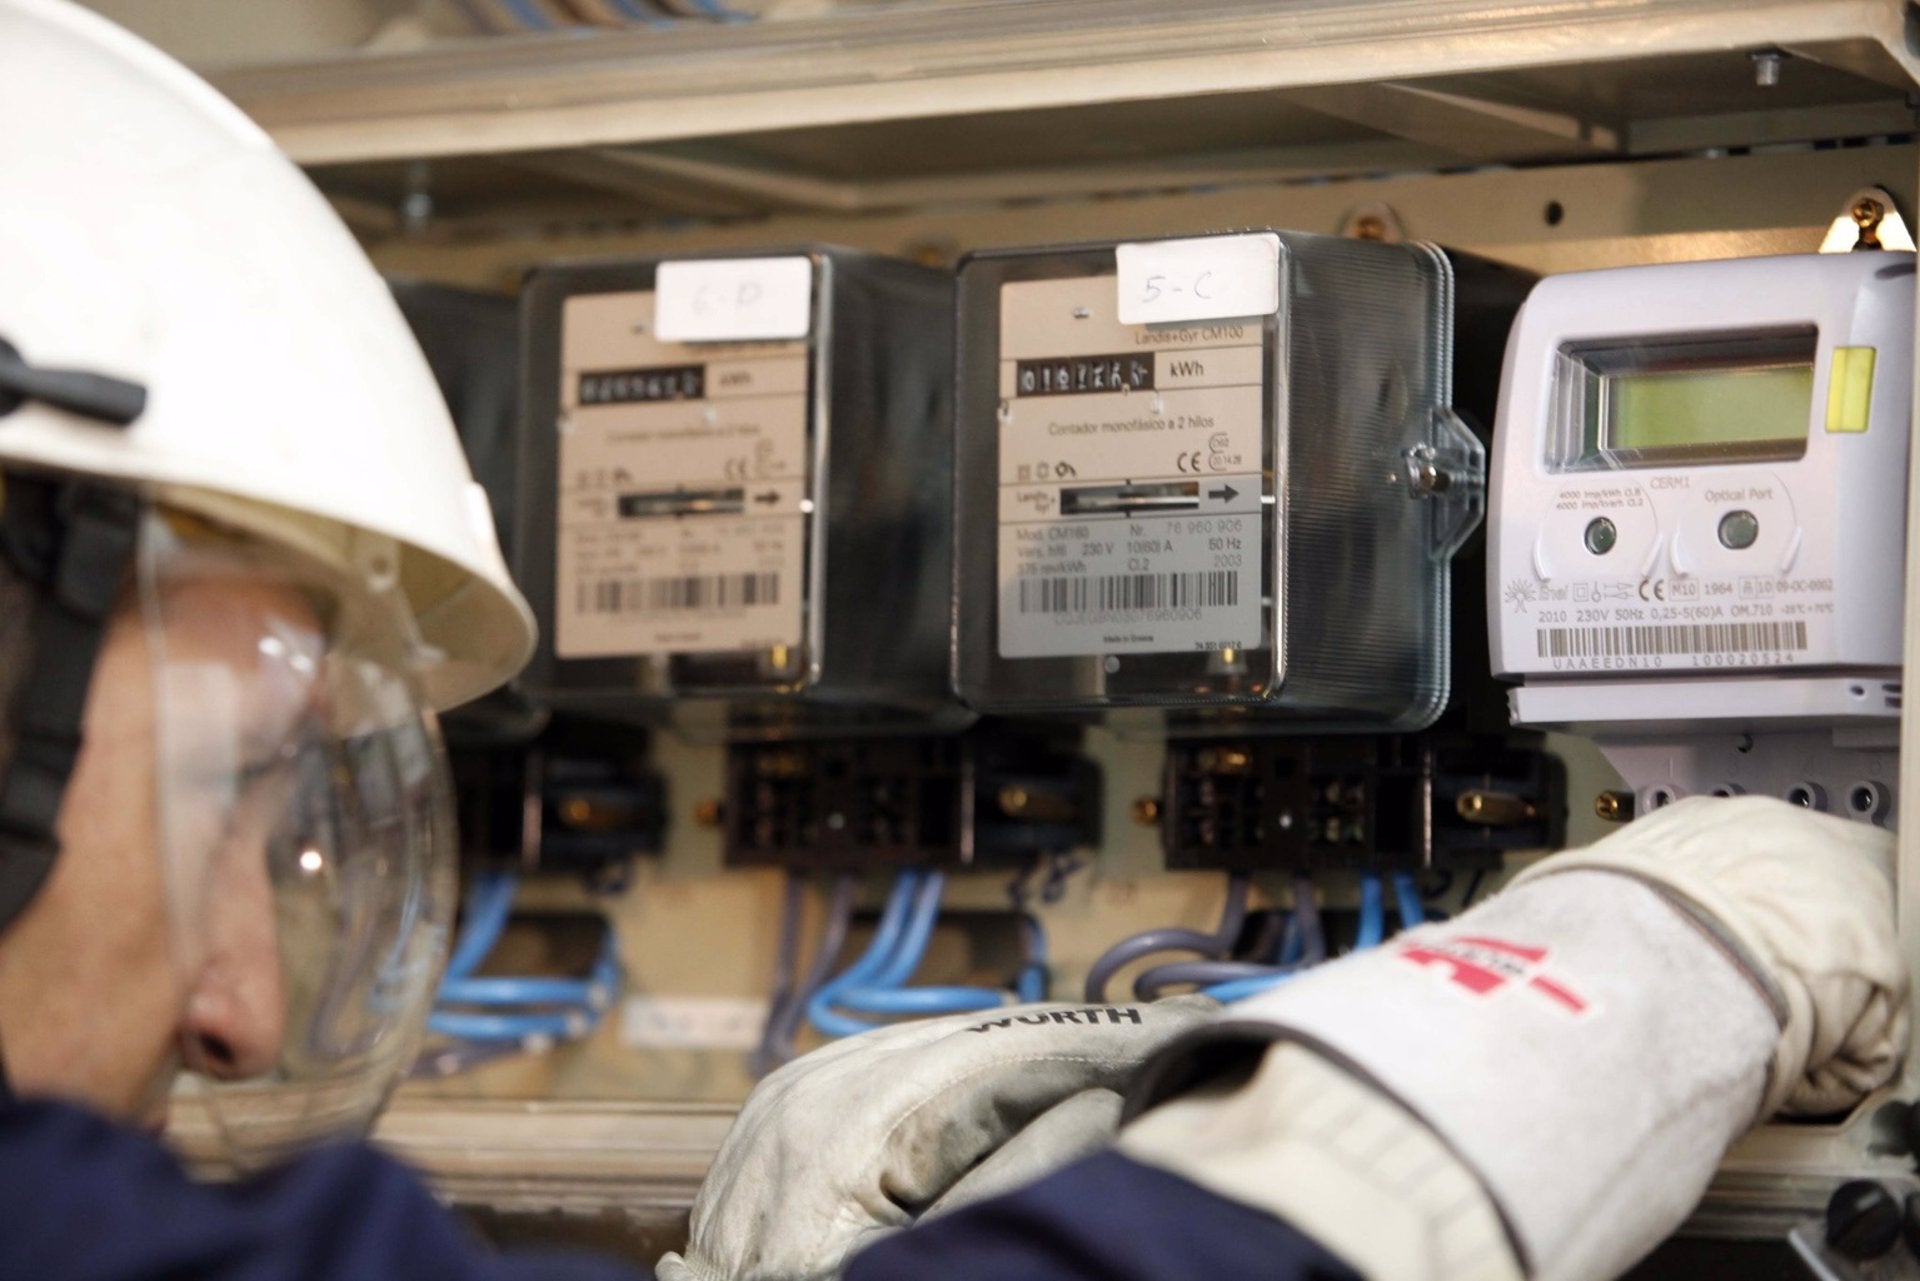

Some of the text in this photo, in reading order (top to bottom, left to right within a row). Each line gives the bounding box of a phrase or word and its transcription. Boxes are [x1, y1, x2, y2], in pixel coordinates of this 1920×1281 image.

[1170, 361, 1204, 377] kWh
[1049, 421, 1099, 437] Contador
[1177, 417, 1186, 430] 2
[1188, 415, 1215, 430] hilos
[1705, 486, 1774, 503] Optical Port
[1163, 539, 1174, 553] A
[1226, 537, 1242, 551] Hz
[1539, 610, 1567, 623] 2010
[1577, 609, 1610, 622] 230V
[1615, 608, 1645, 621] 50Hz
[1553, 655, 1662, 670] UAAEEDN10
